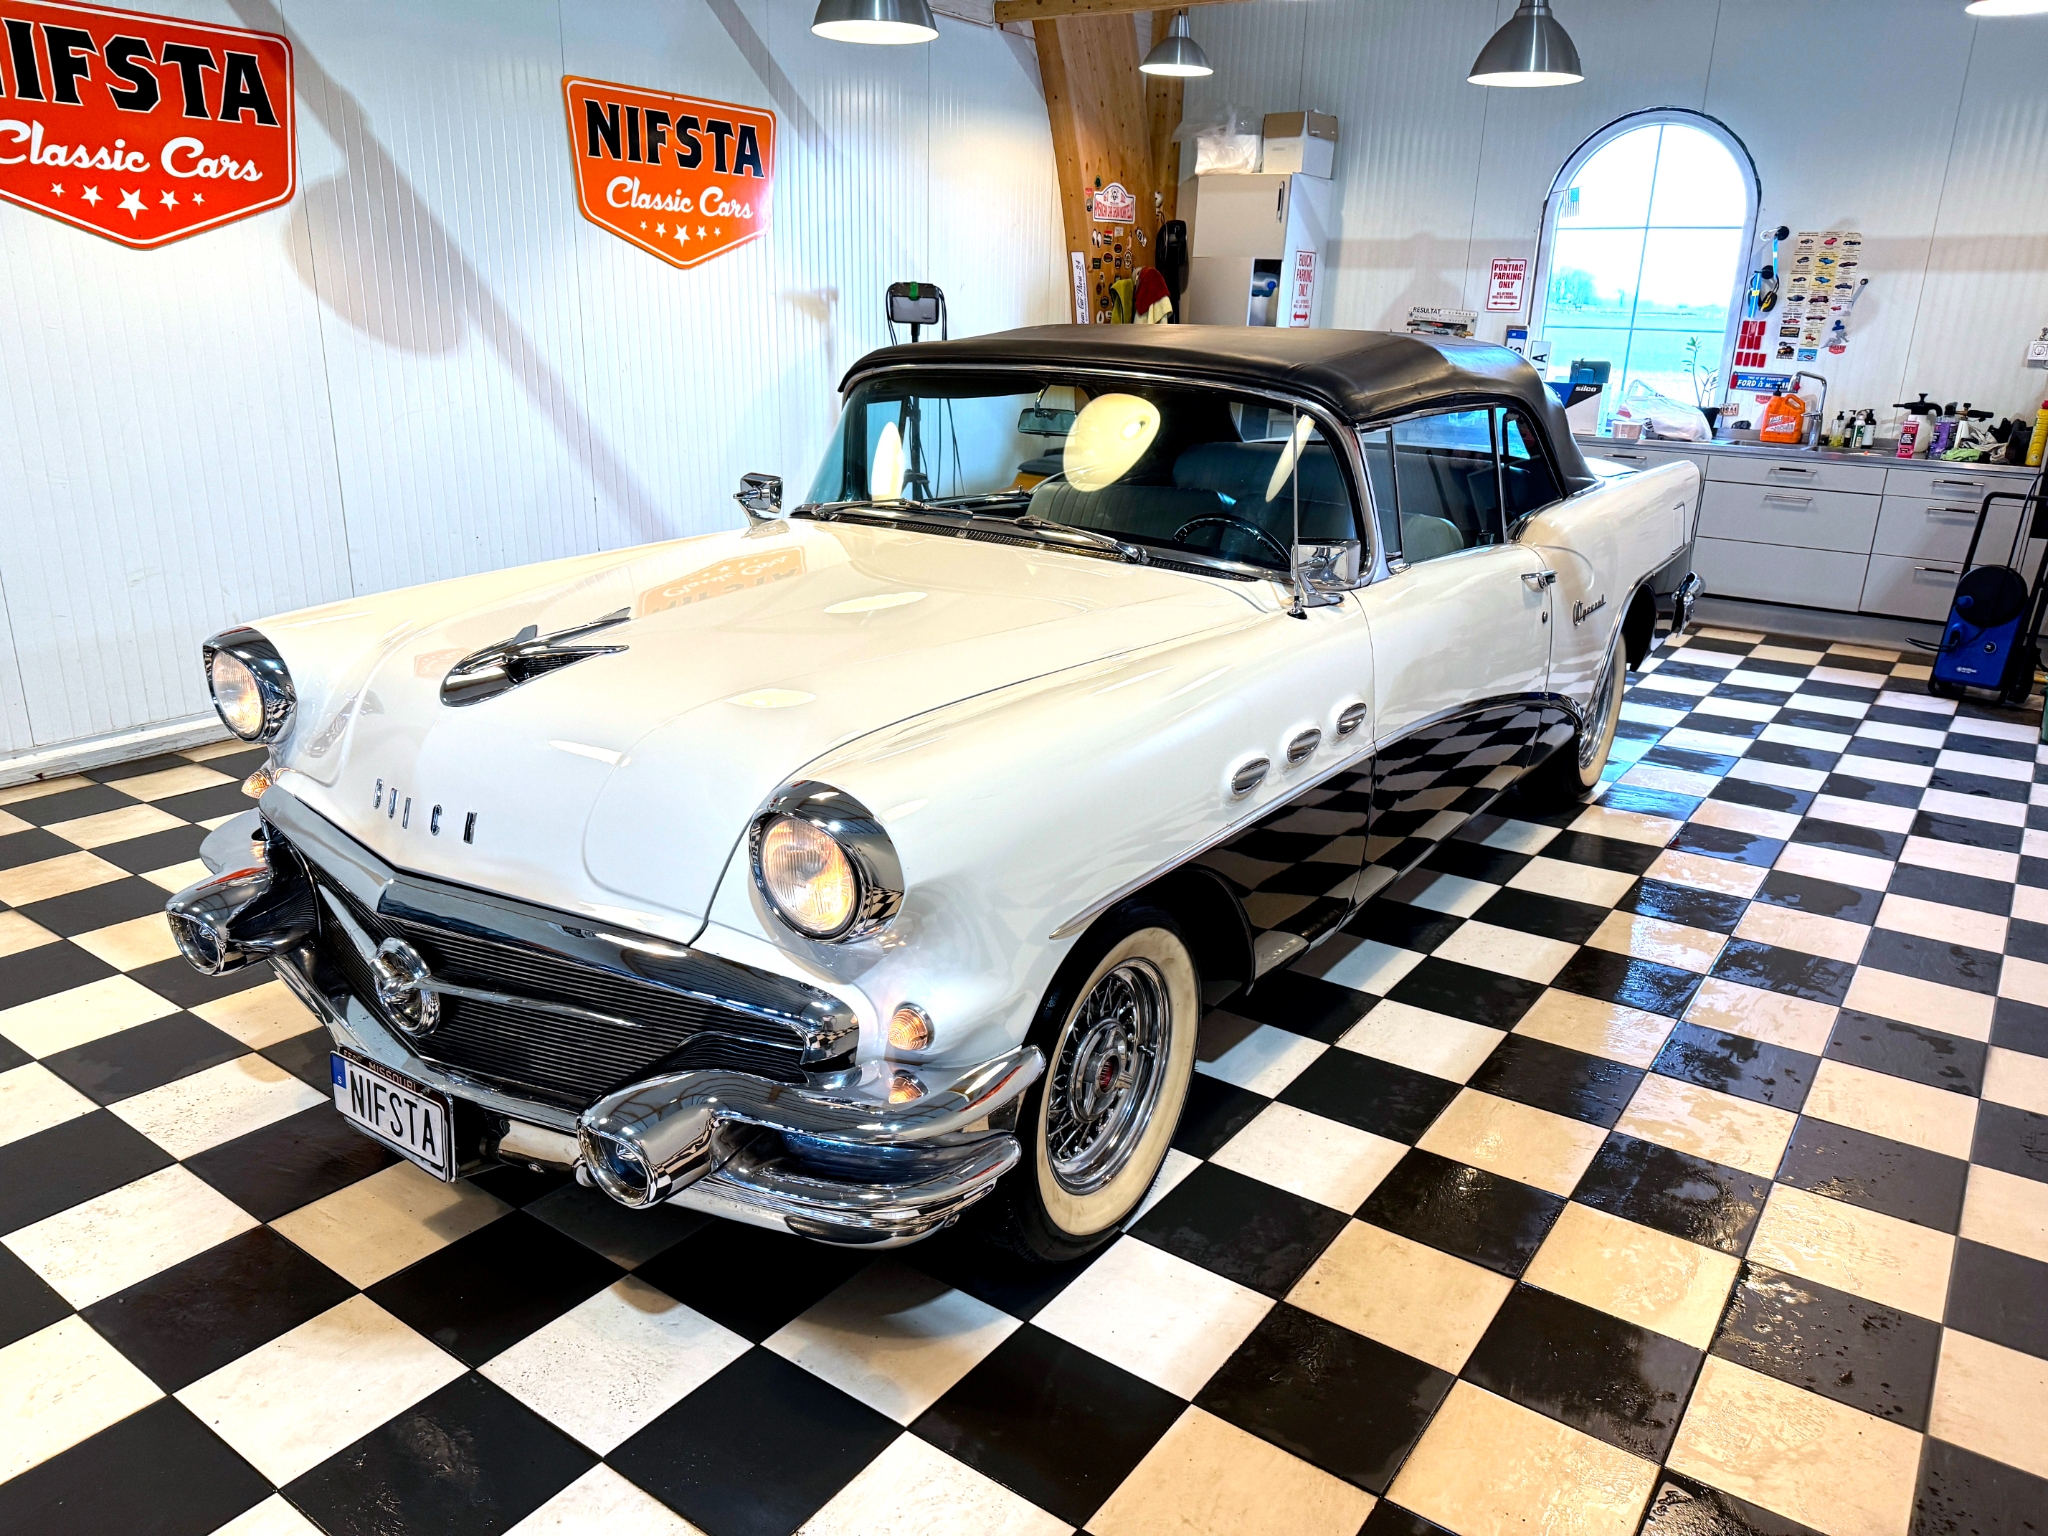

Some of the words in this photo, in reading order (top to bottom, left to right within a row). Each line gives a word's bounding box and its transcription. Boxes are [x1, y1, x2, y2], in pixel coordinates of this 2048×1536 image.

[0, 17, 281, 128] IFSTA
[583, 98, 765, 179] NIFSTA
[0, 119, 150, 173] Classic
[161, 136, 263, 182] Cars
[606, 175, 694, 214] Classic
[699, 186, 753, 219] Cars
[1493, 263, 1524, 272] PONTIAC
[1493, 272, 1522, 280] PARKING
[1498, 281, 1515, 289] ONLY
[1412, 306, 1442, 315] RESULTAT
[1575, 385, 1597, 393] silco
[1737, 379, 1757, 388] FORD
[372, 778, 478, 845] BUICK
[337, 1075, 343, 1085] S
[368, 1061, 417, 1092] MISSOURI
[350, 1070, 436, 1157] NIFSTA
